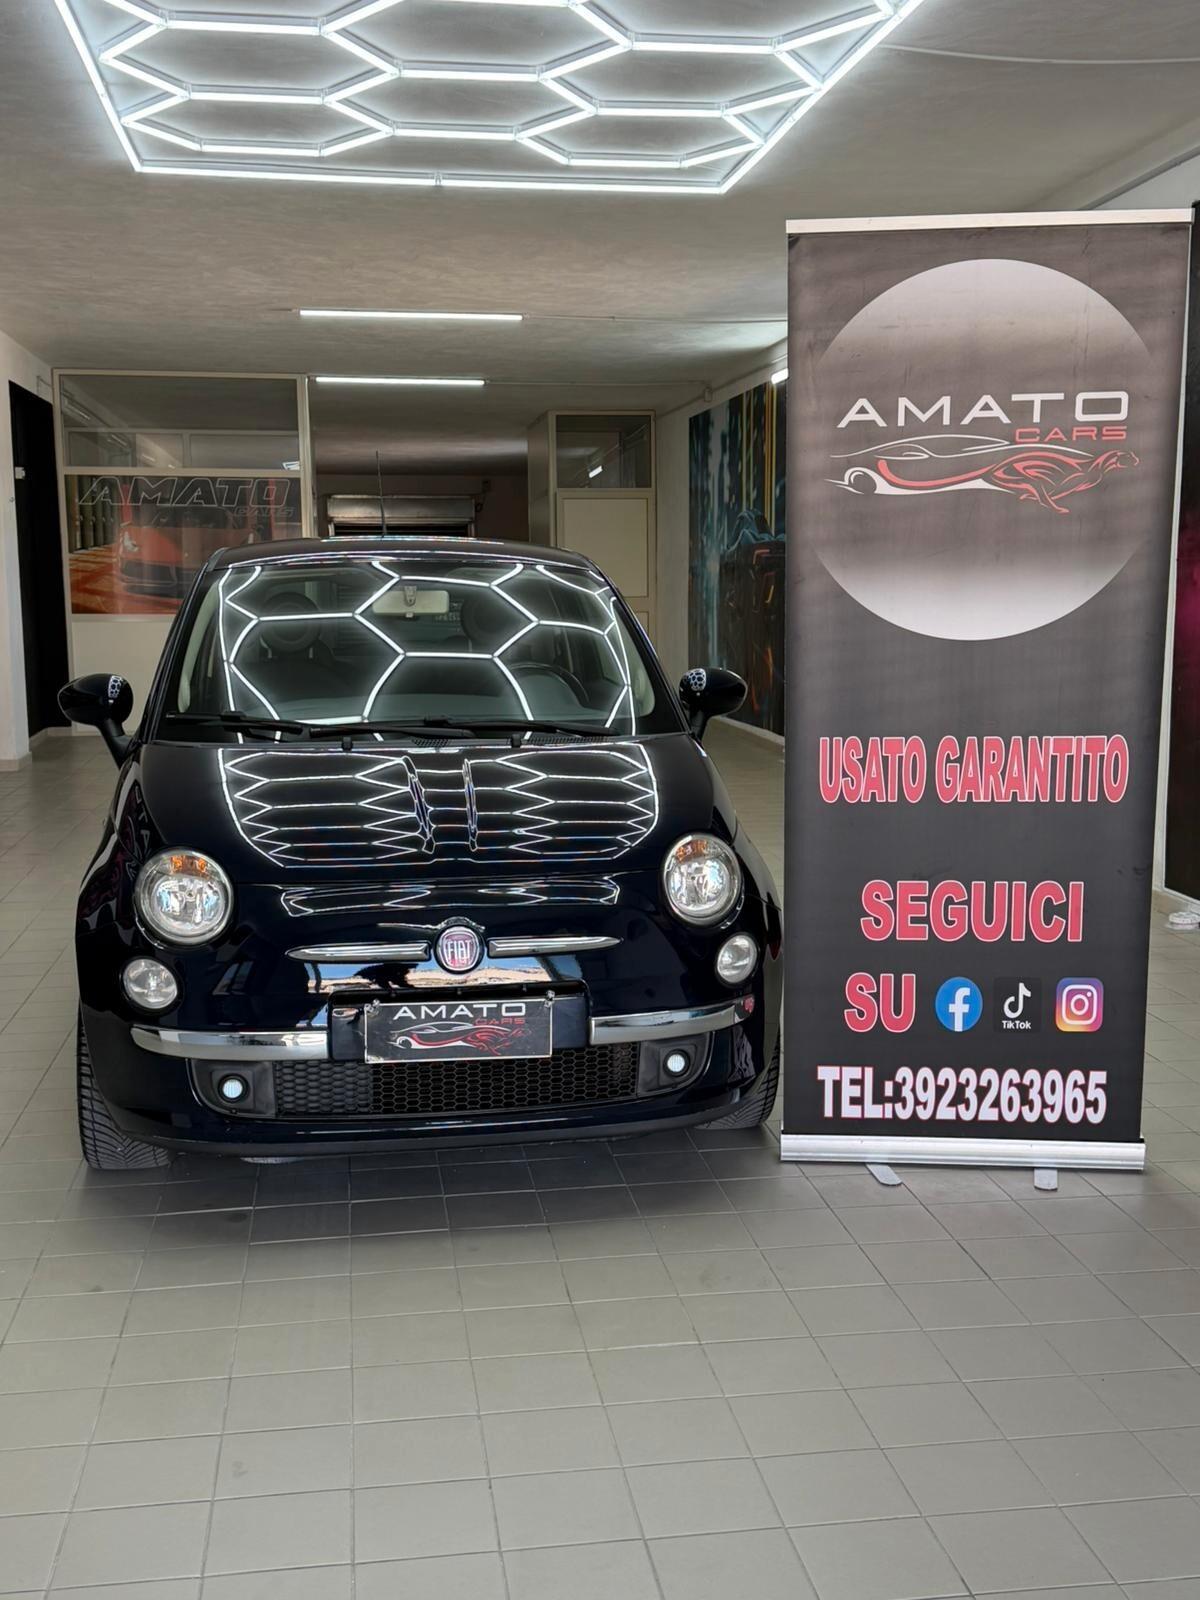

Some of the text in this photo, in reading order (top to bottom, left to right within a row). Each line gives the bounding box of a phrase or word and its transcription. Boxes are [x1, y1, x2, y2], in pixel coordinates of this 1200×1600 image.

[836, 390, 1129, 428] AMATO
[1015, 425, 1127, 443] CARS
[78, 476, 290, 508] AMATO
[819, 735, 1129, 803] USATO GARANTITO
[860, 880, 1084, 942] SEGUICI
[447, 939, 472, 960] FIAT
[393, 1002, 526, 1020] AMATO
[844, 972, 916, 1032] SU
[1001, 1020, 1032, 1030] TikTok
[474, 1016, 526, 1025] CARS
[817, 1065, 1108, 1125] TEL:3923263965
